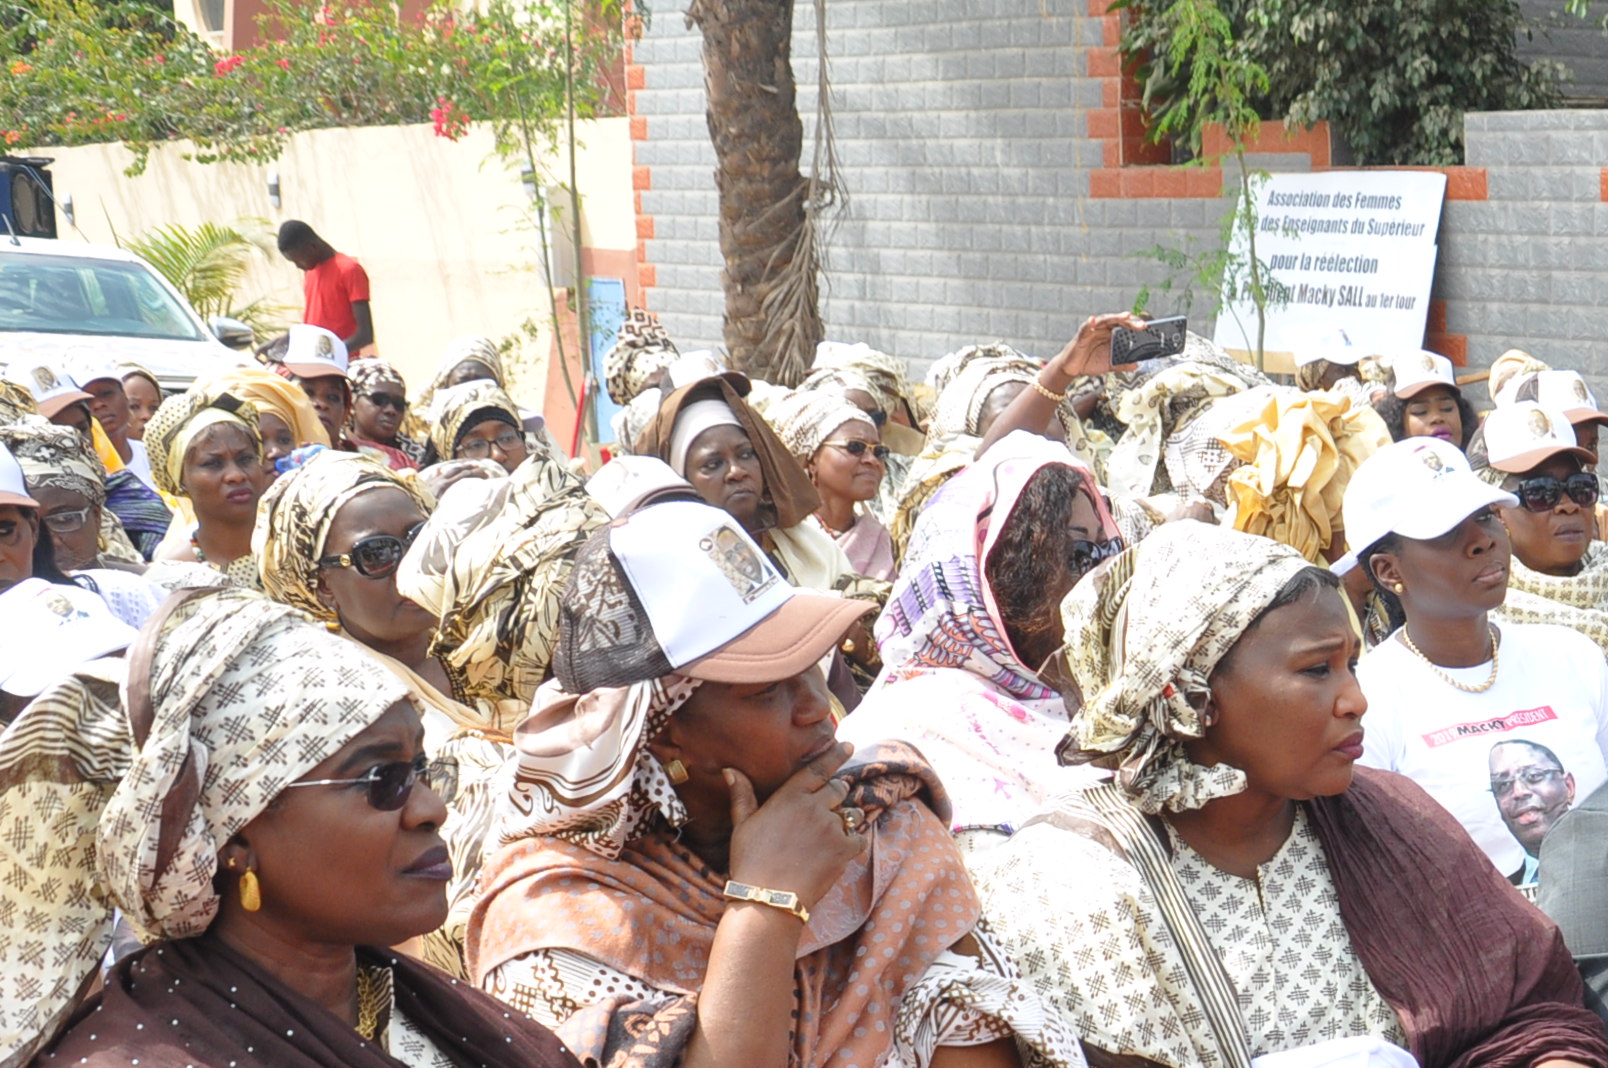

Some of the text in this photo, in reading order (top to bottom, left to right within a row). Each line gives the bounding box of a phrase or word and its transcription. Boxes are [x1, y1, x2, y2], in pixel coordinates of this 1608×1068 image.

[1267, 190, 1402, 210] Association des Femmes
[1261, 215, 1281, 232] des
[1282, 216, 1349, 235] Enseignants
[1350, 218, 1365, 235] du
[1367, 218, 1425, 237] Supérieur
[1270, 252, 1379, 274] pour la réélection
[1297, 283, 1336, 308] Macky
[1338, 284, 1364, 307] SALL
[1365, 294, 1377, 308] au
[1379, 293, 1394, 310] 1er
[1395, 296, 1417, 310] tour
[1429, 708, 1550, 746] 2019 MACKY PRESIDENT
